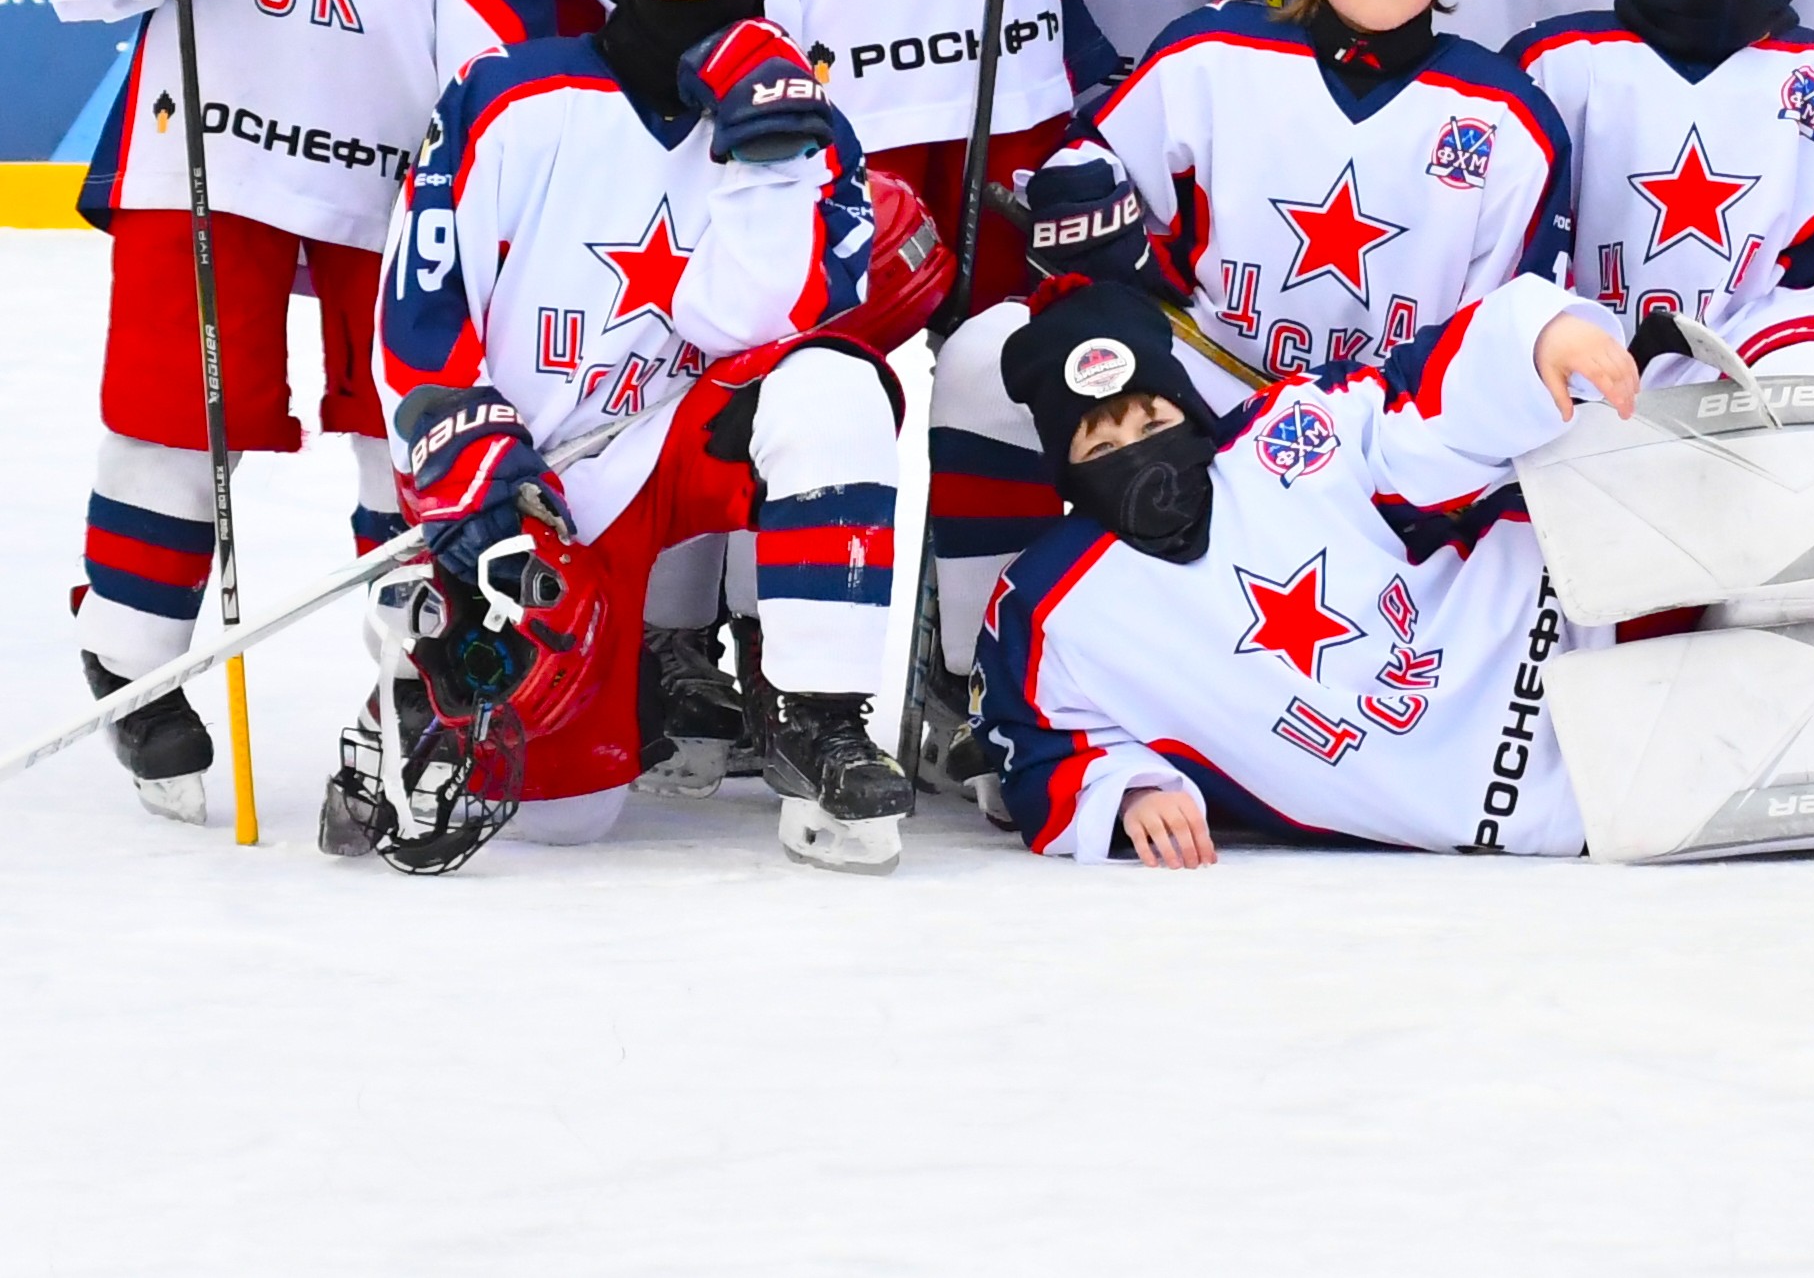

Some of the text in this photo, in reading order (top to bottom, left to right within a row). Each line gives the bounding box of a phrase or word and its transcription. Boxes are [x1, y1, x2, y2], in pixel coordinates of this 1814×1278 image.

[1437, 145, 1490, 174] ФХМ
[1032, 192, 1140, 249] BAUE
[204, 323, 218, 391] BAUER
[410, 403, 525, 472] BAUE
[1275, 420, 1328, 466] ФХМ
[1473, 567, 1563, 854] РОСНЕФТ
